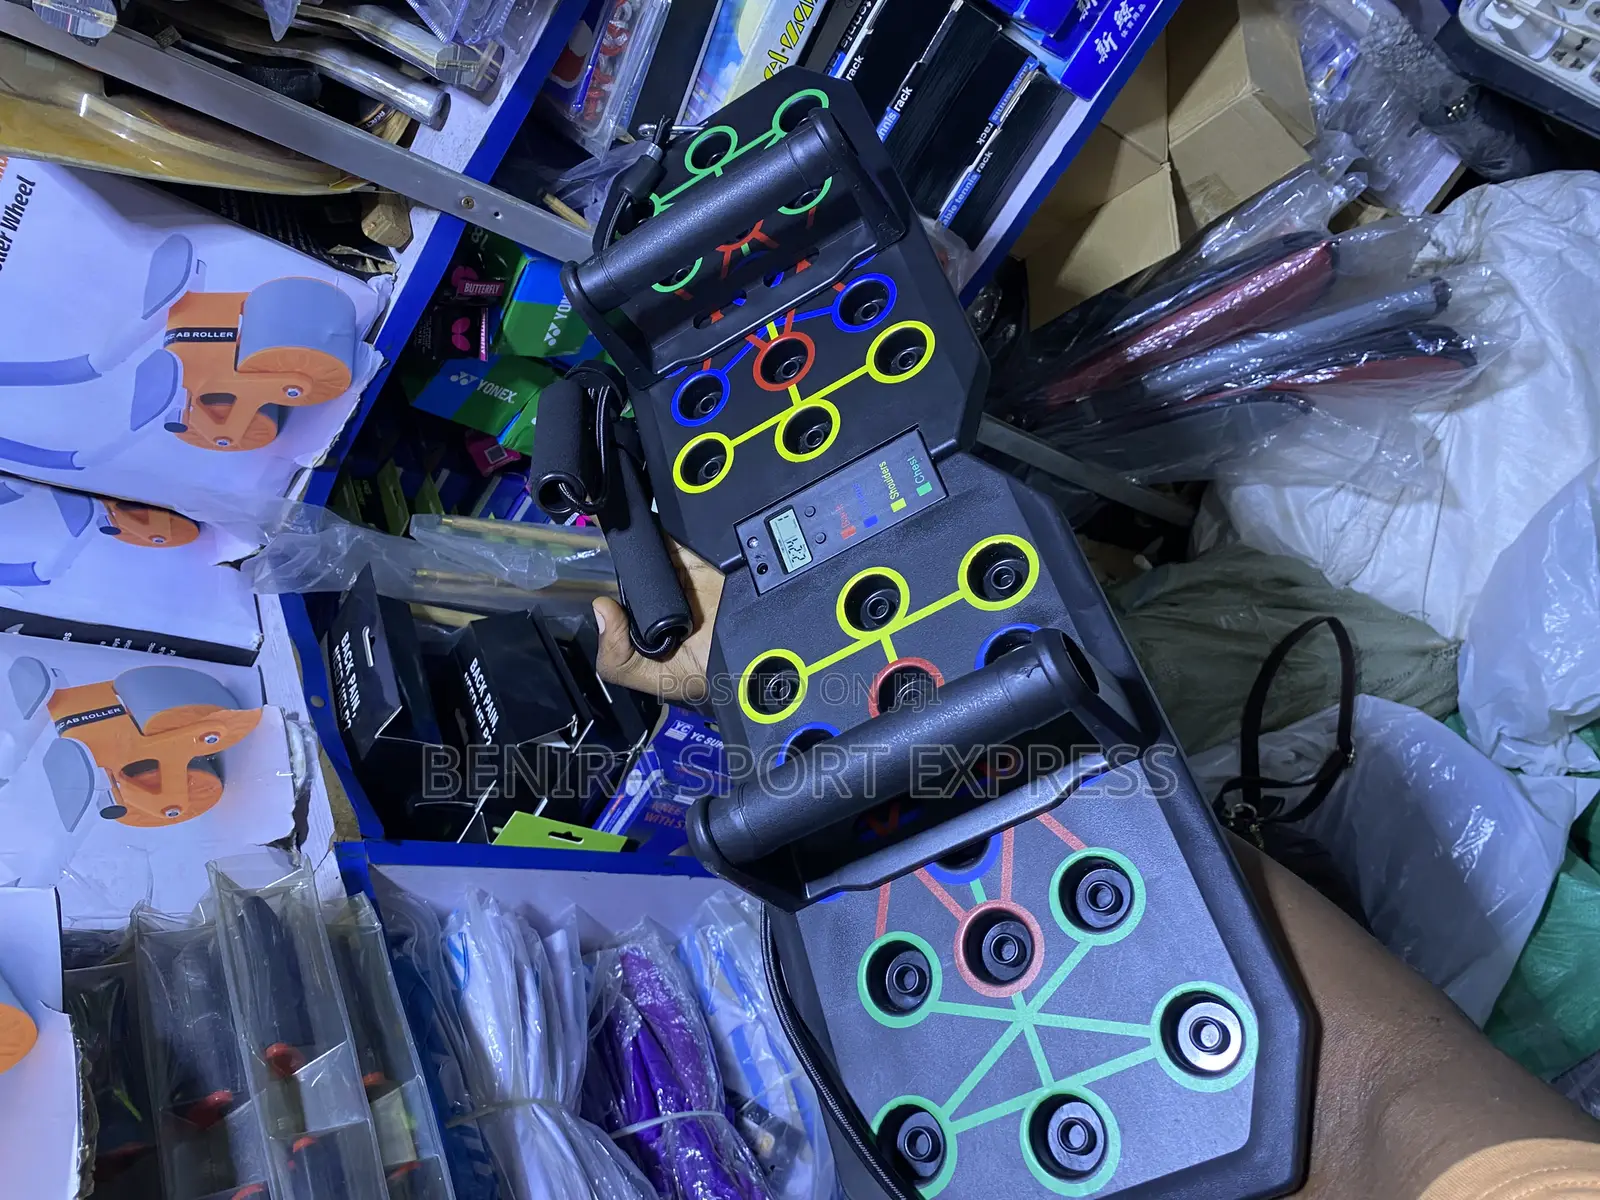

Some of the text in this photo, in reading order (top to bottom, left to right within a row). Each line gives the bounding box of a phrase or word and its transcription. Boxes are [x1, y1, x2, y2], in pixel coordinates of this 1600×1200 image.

[845, 54, 865, 81] rack
[893, 86, 913, 112] rack
[975, 122, 993, 146] rack
[954, 174, 978, 204] tennis
[976, 150, 993, 173] rack
[0, 174, 36, 232] Wheel
[464, 282, 501, 294] BUTTERFLY
[477, 379, 517, 404] YONEX
[879, 461, 900, 500] Shoulders
[907, 456, 925, 484] Chest
[341, 631, 361, 719] BACK PAIN,
[469, 657, 499, 734] BACK PAIN,
[66, 707, 121, 725] AB ROLLER
[690, 731, 705, 742] YC
